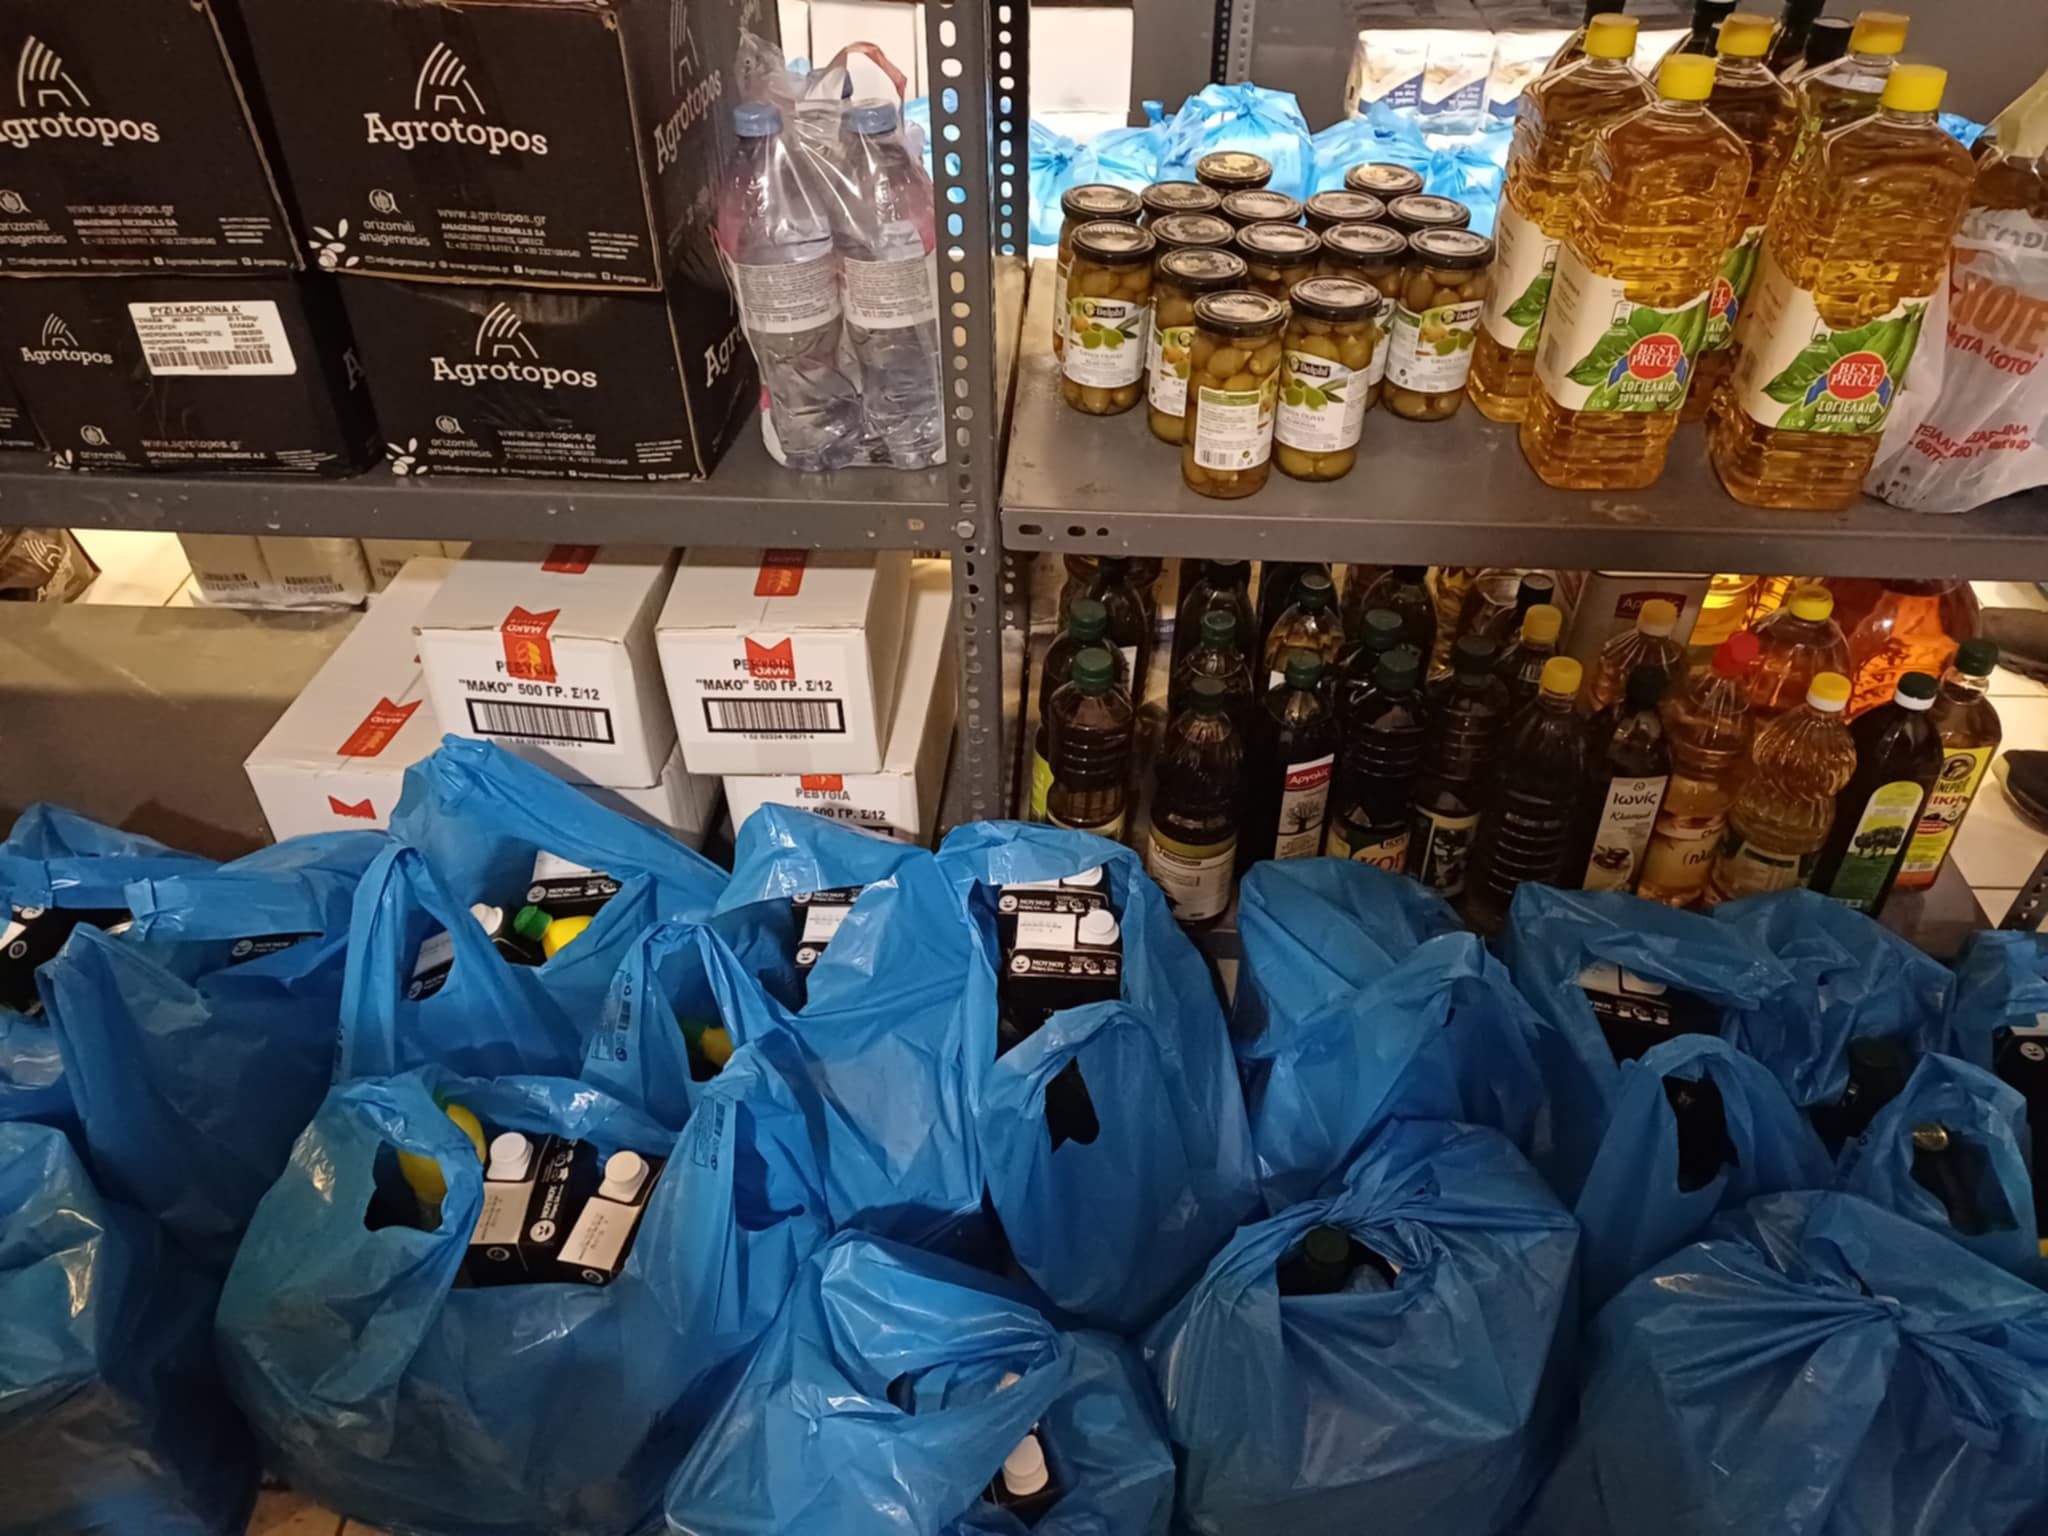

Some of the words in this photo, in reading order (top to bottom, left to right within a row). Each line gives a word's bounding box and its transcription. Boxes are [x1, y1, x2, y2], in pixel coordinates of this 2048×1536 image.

[654, 69, 722, 175] Agrotopos
[364, 113, 548, 155] Agrotopos
[437, 208, 546, 226] www.agrotopos.gr
[175, 305, 228, 314] ΚΑΡΟΛΙΝΑ
[1638, 342, 1678, 356] BEST
[19, 347, 113, 366] Agrotopos
[1631, 354, 1678, 368] PRICE
[430, 356, 598, 388] Agrotopos
[1300, 362, 1330, 377] Delphi
[1837, 362, 1880, 374] BEST
[1831, 374, 1881, 388] PRICE
[518, 683, 542, 696] 500
[546, 686, 567, 699] ΓΡ.
[572, 687, 600, 700] Σ/12
[754, 680, 777, 691] 500
[781, 681, 801, 692] ΓΡ.
[806, 681, 833, 692] Σ/12
[796, 787, 850, 800] ΡΕΒΥΘΙΑ
[838, 808, 856, 819] ΓΡ.
[860, 809, 886, 821] Σ/12
